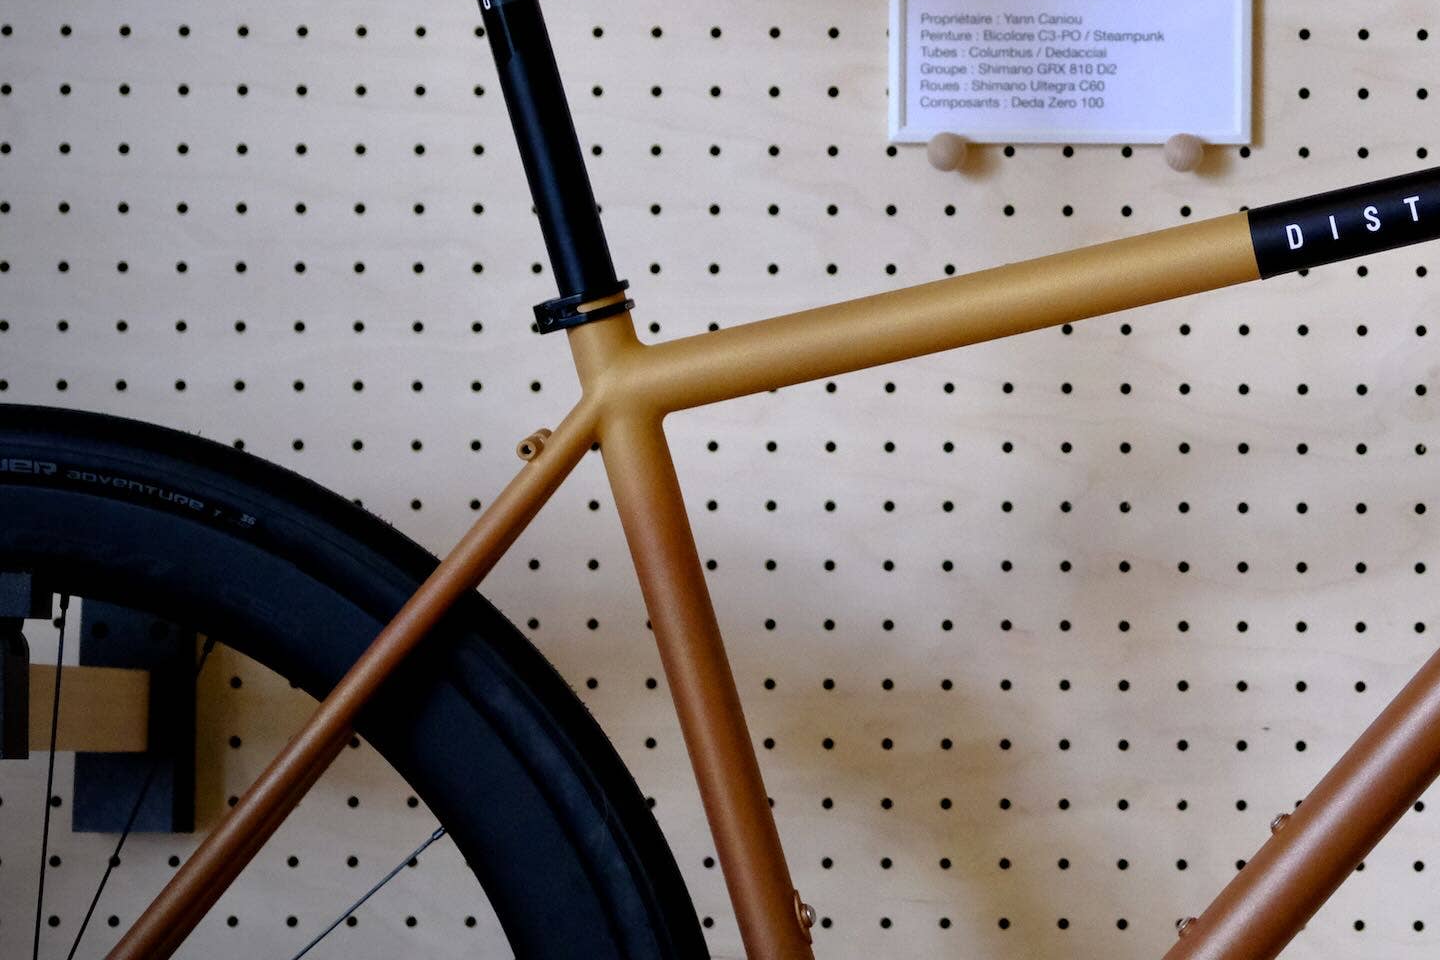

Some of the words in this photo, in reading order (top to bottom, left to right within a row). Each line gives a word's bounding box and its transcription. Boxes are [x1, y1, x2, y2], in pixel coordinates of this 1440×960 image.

[921, 13, 993, 27] Propriétaire
[1003, 13, 1035, 26] Yann
[1038, 13, 1083, 26] Caniou
[921, 29, 972, 42] Peinture
[983, 29, 1035, 42] Bicolore
[1038, 29, 1082, 42] C3-PO
[1093, 29, 1165, 45] Steampunk
[921, 46, 958, 58] Tubes
[968, 46, 1033, 58] Columbus
[920, 62, 967, 77] Groupe
[978, 62, 1033, 75] Shimano
[1037, 63, 1066, 75] GRX
[1096, 63, 1118, 75] Di2
[920, 79, 960, 91] Roues
[971, 79, 1027, 91] Shimano
[1030, 79, 1076, 94] Ultegra
[1079, 79, 1106, 92] C60
[919, 95, 1001, 110] Composants
[1011, 96, 1045, 109] Deda
[1048, 96, 1078, 109] Zero
[1081, 96, 1106, 109] 100
